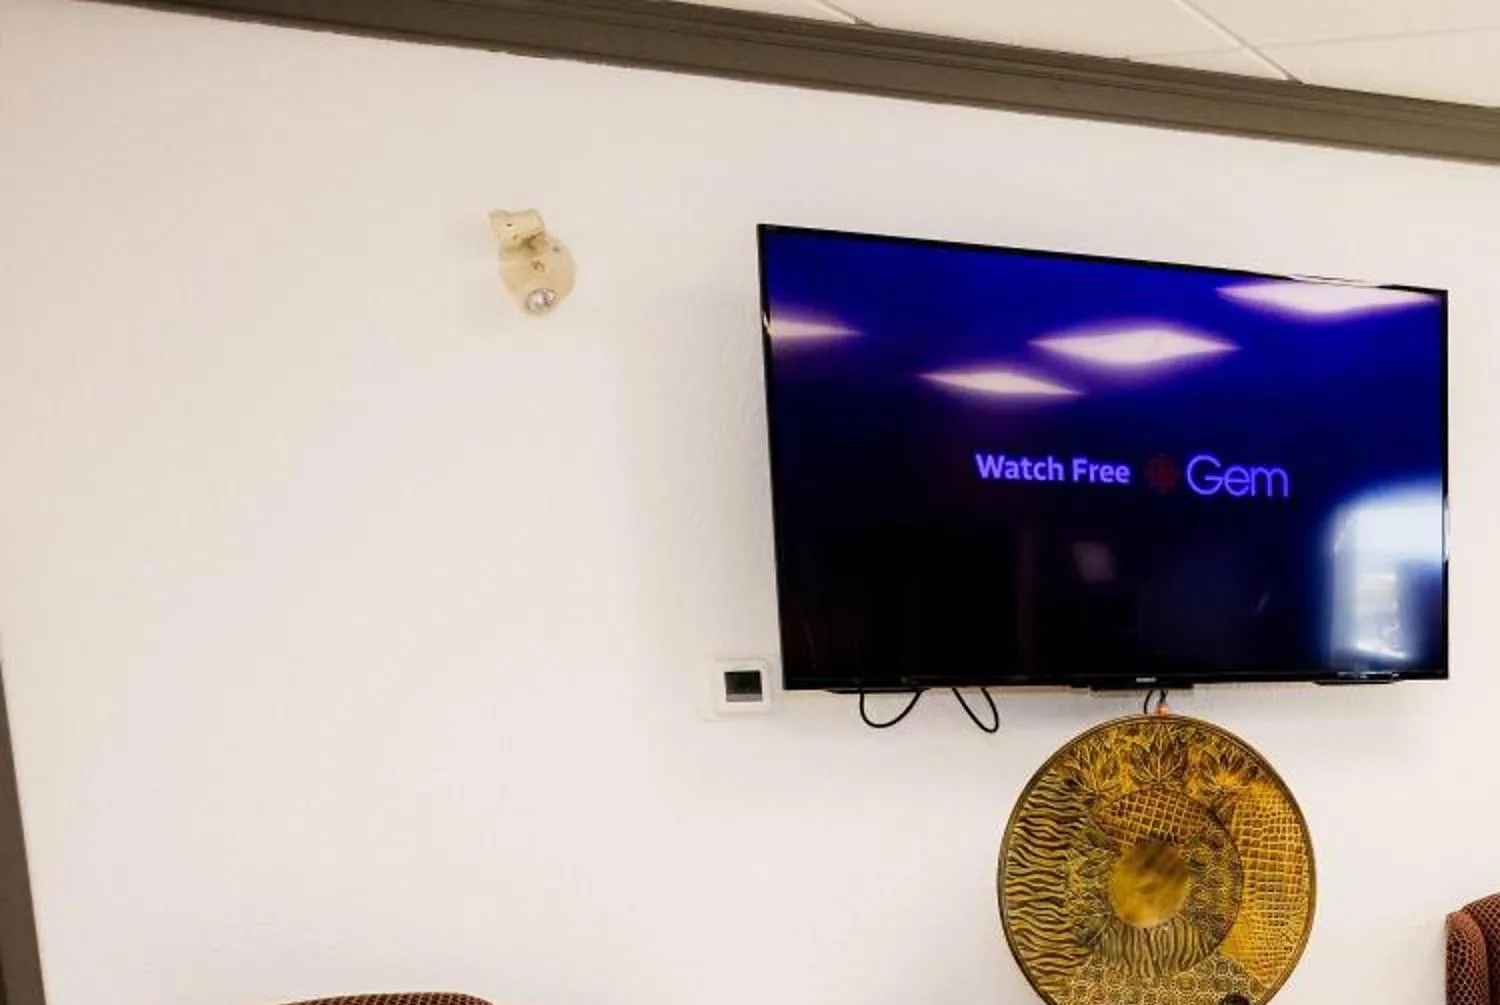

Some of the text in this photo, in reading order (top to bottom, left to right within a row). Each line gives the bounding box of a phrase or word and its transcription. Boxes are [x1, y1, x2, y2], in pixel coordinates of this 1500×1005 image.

[975, 453, 1289, 497] Watch Free Gem
